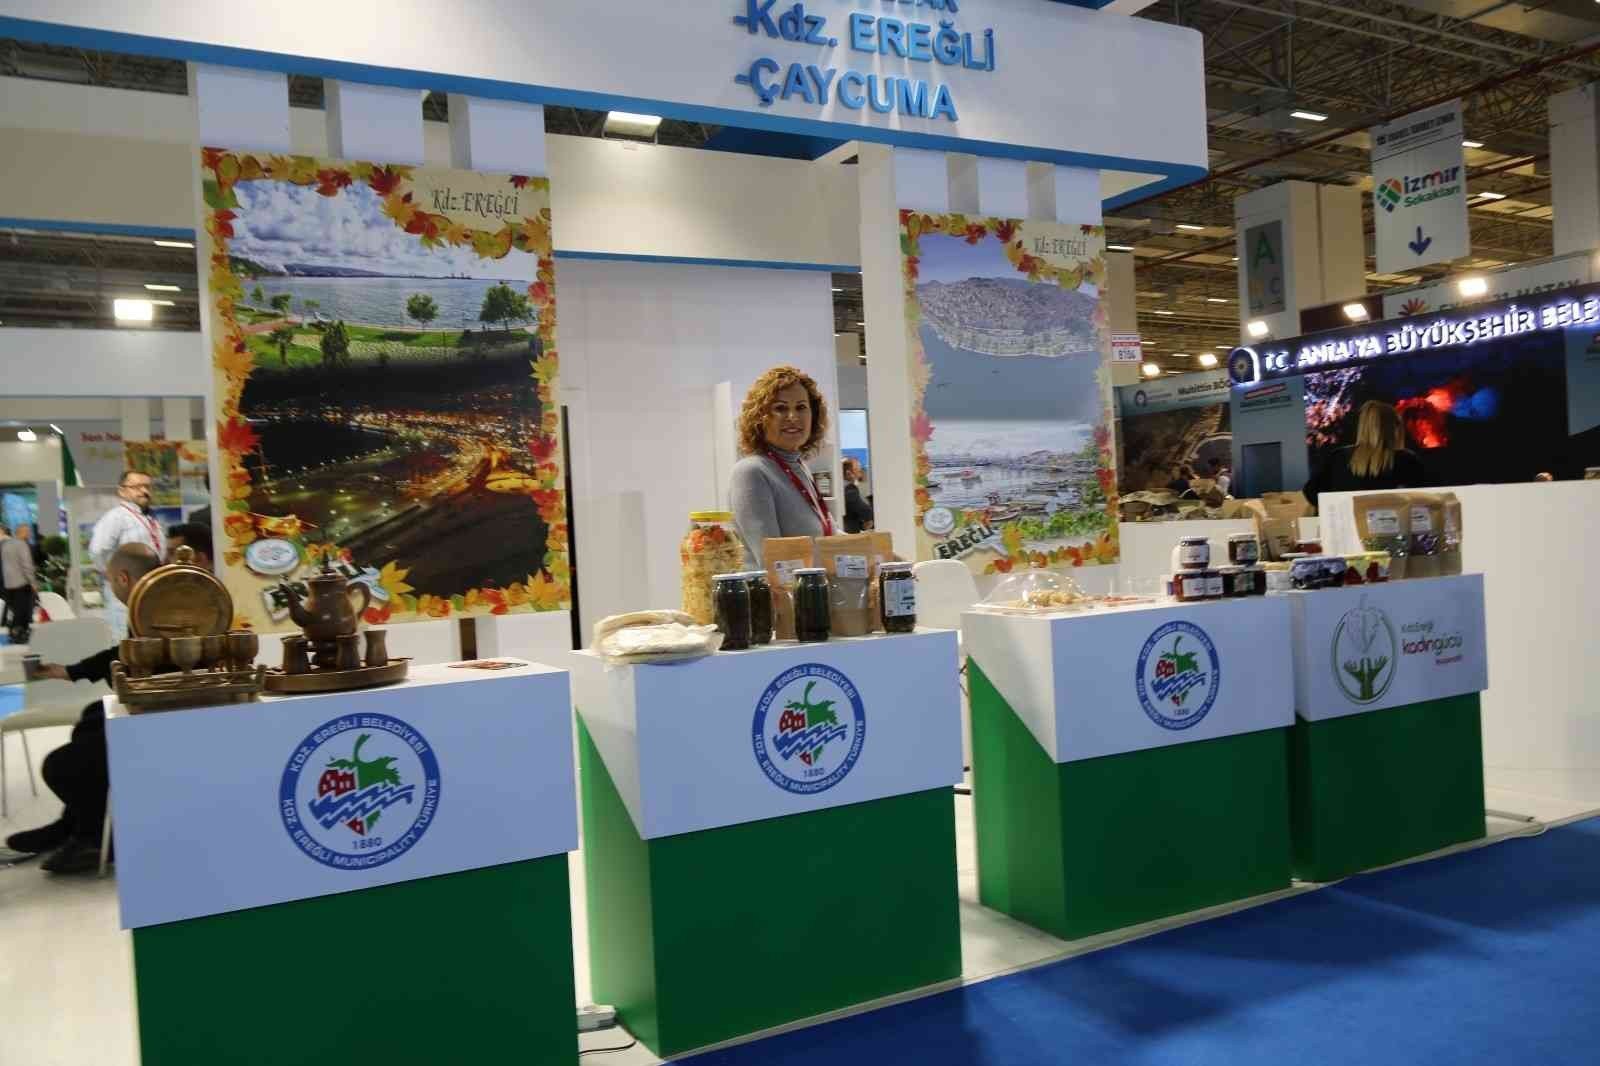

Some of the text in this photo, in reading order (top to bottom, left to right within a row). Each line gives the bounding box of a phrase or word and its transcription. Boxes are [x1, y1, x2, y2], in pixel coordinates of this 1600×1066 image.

[849, 12, 995, 71] EREĞLİ
[1298, 336, 1382, 368] ANTALYA
[1386, 304, 1536, 354] BÜYÜKŞEHİR
[352, 837, 383, 849] 1880
